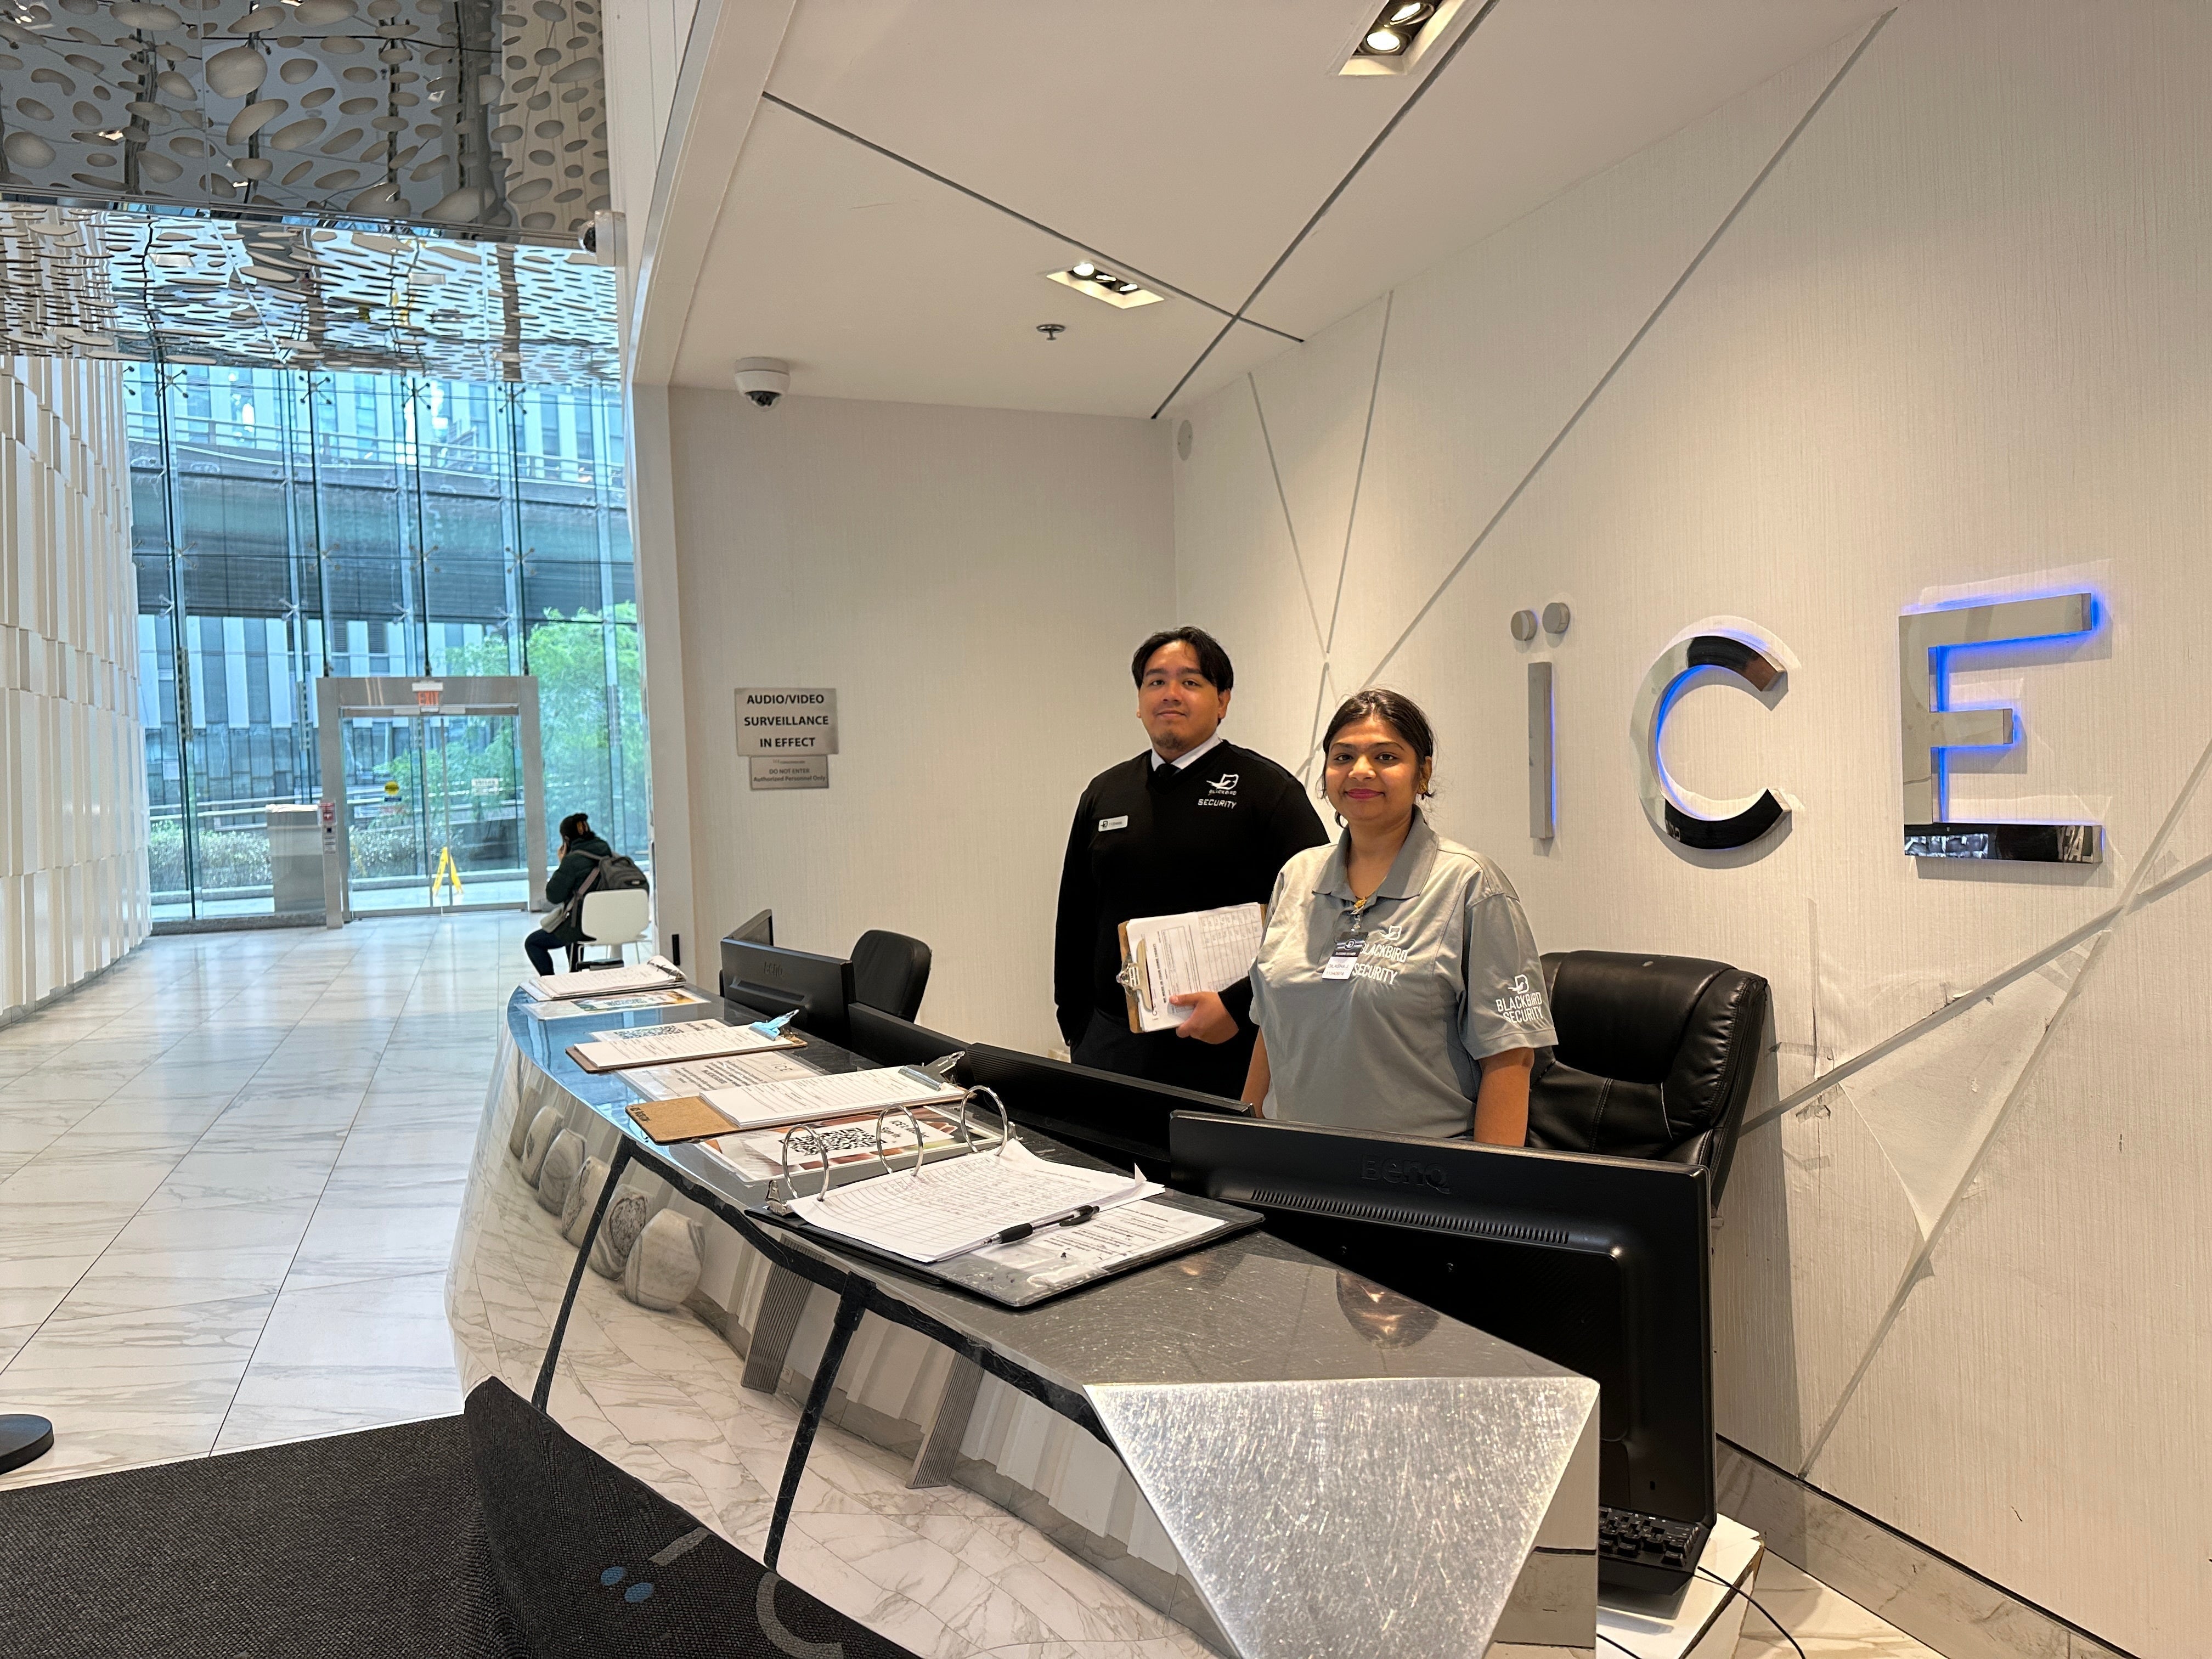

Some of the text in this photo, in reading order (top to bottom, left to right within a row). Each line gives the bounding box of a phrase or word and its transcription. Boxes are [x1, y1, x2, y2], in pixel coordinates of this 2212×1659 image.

[417, 691, 439, 706] EXIT
[747, 695, 824, 704] AUDIO/VIDEO
[744, 715, 829, 726] SURVEILLANCE
[760, 737, 815, 748] IN EFFECT
[1198, 799, 1237, 809] SECURITY
[1352, 963, 1398, 985] SECURITY
[1496, 992, 1543, 1012] BLACKBIRD
[1503, 1006, 1543, 1023] SECURITY
[1361, 1154, 1452, 1194] BenQ
